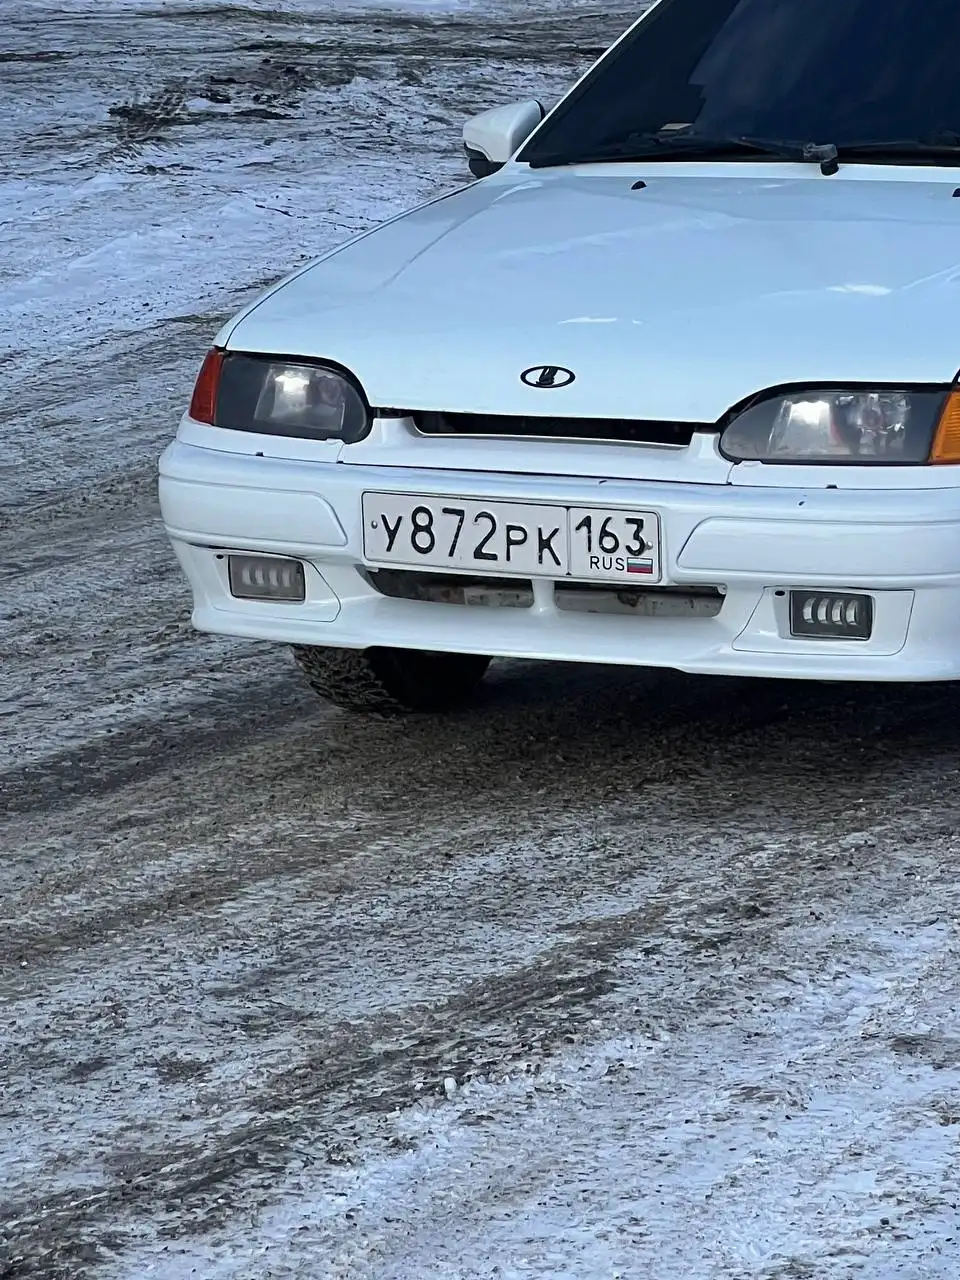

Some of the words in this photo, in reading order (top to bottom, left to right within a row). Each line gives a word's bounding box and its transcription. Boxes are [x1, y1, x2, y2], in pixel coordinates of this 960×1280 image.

[381, 505, 561, 566] У872РК
[575, 515, 647, 556] 163
[590, 555, 625, 571] RUS
